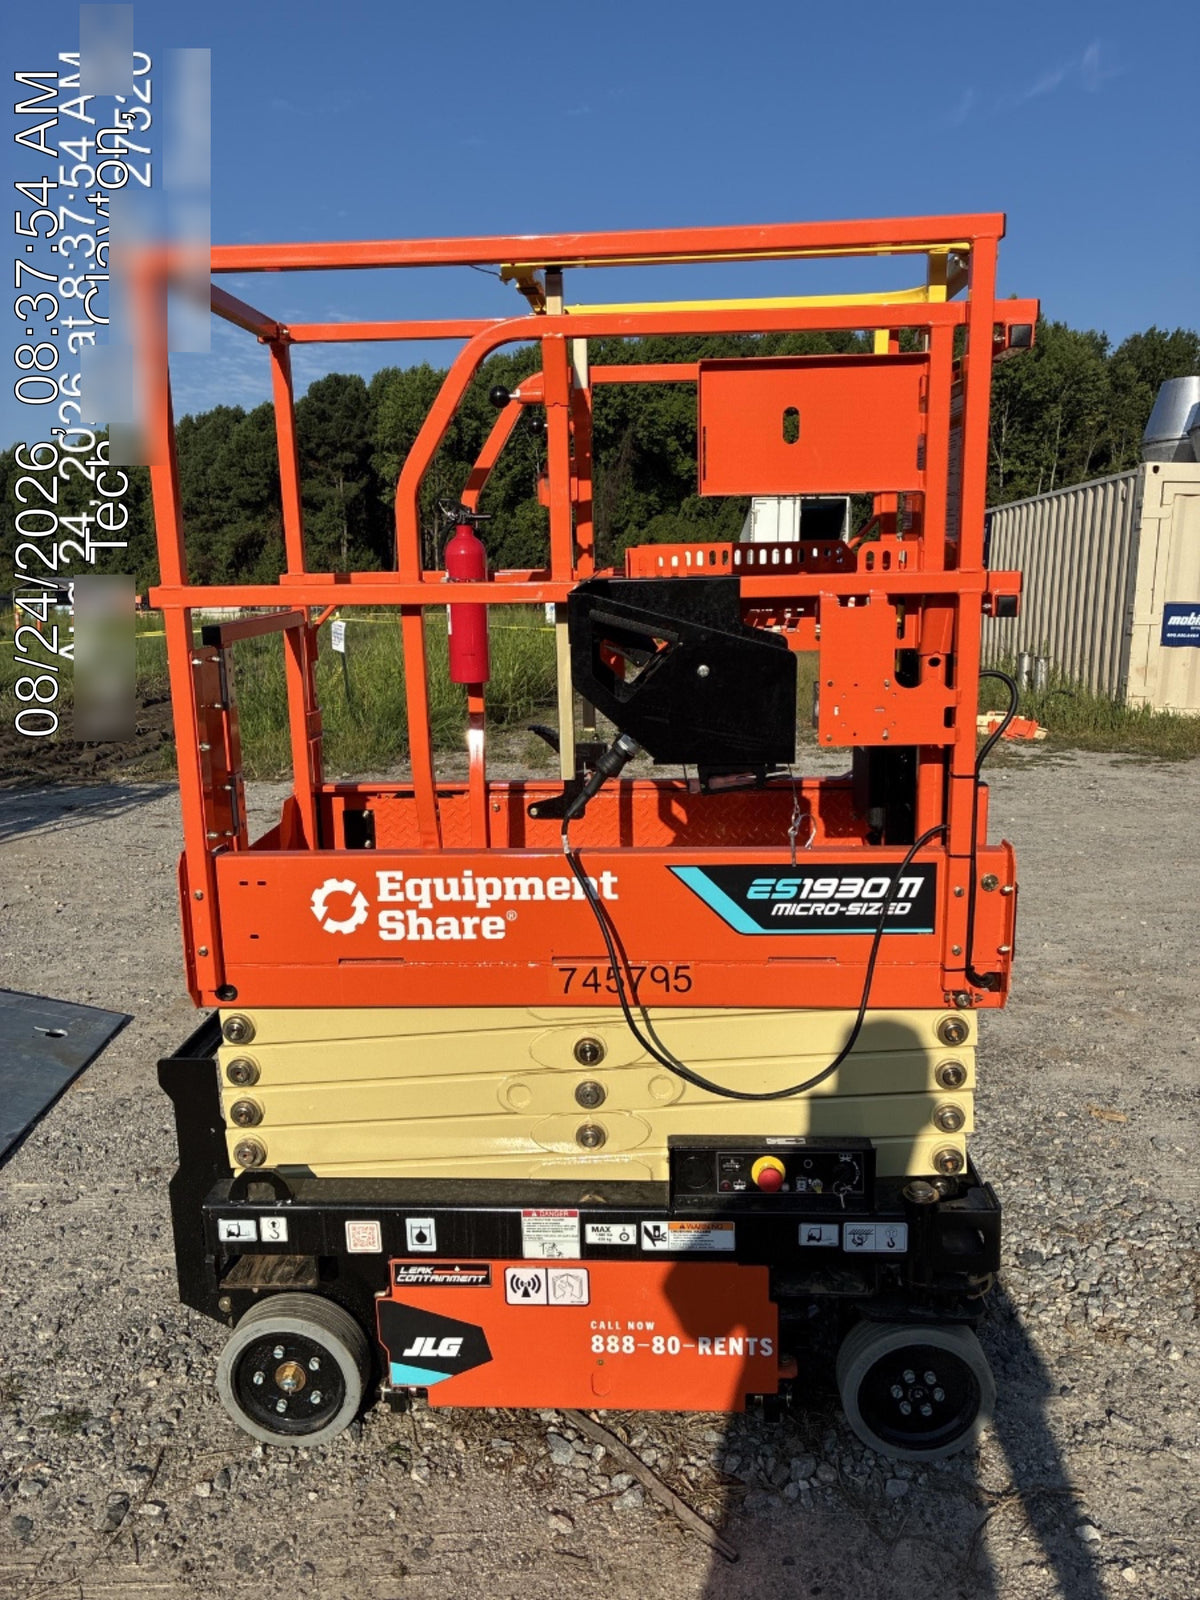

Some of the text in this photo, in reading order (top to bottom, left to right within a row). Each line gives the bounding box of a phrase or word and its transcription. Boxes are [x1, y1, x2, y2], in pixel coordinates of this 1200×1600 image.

[1167, 612, 1200, 626] mobi
[375, 869, 619, 909] Equipment
[770, 902, 912, 916] MICRO-SIZED
[558, 965, 693, 994] 745795
[399, 1265, 435, 1274] LEAK
[396, 1274, 486, 1283] CONTAINMENT
[590, 1320, 656, 1331] CALL NOW
[402, 1336, 464, 1357] JLG
[590, 1335, 774, 1357] 888-80-RENTS
